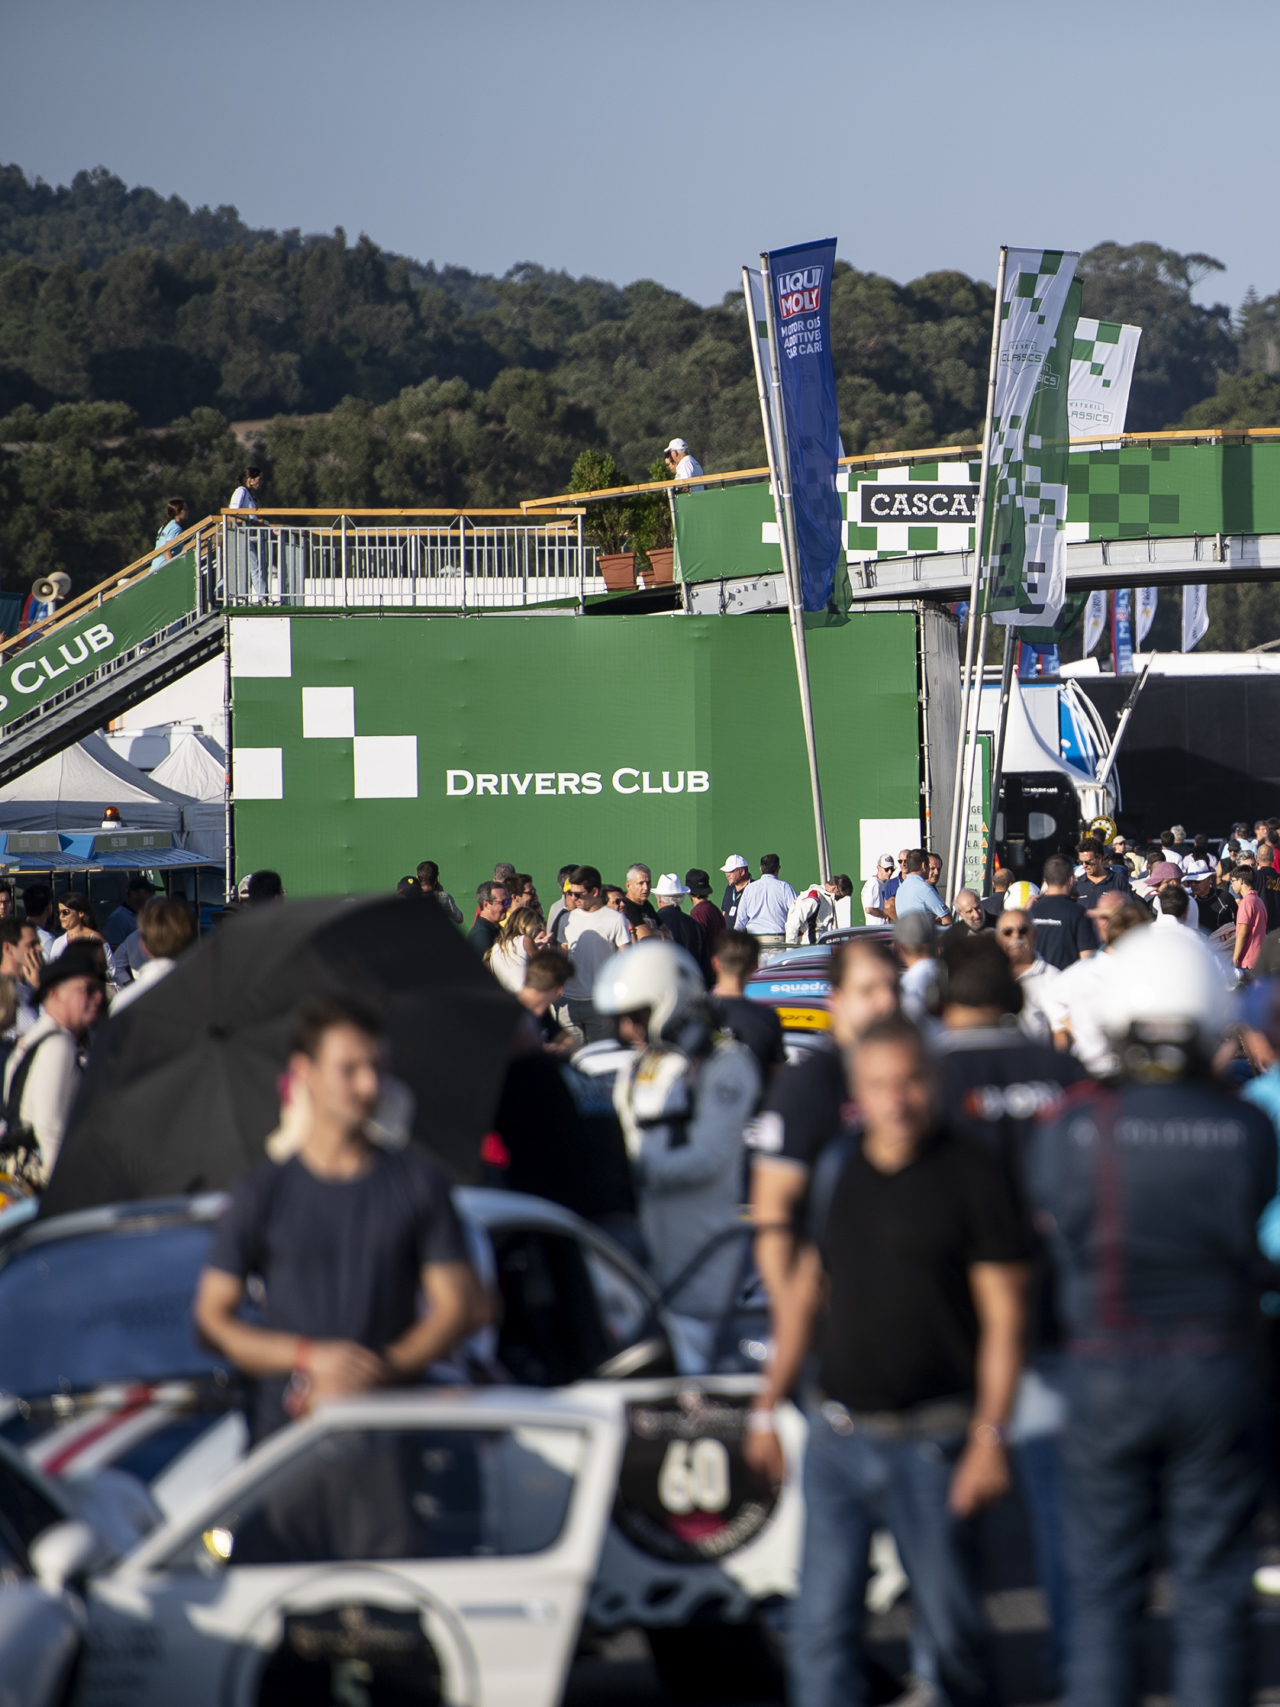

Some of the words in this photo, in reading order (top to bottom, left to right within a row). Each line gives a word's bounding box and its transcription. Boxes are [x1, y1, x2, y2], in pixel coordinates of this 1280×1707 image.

[779, 268, 822, 296] LIQUI
[781, 289, 819, 316] MOLY
[781, 320, 805, 338] MOTOR
[786, 346, 798, 359] CAR
[1069, 410, 1109, 423] ASSICS
[870, 493, 980, 516] CASCAI
[10, 623, 115, 694] CLUB
[446, 769, 603, 796] DRIVERS
[612, 767, 710, 794] CLUB
[657, 1438, 731, 1515] 60
